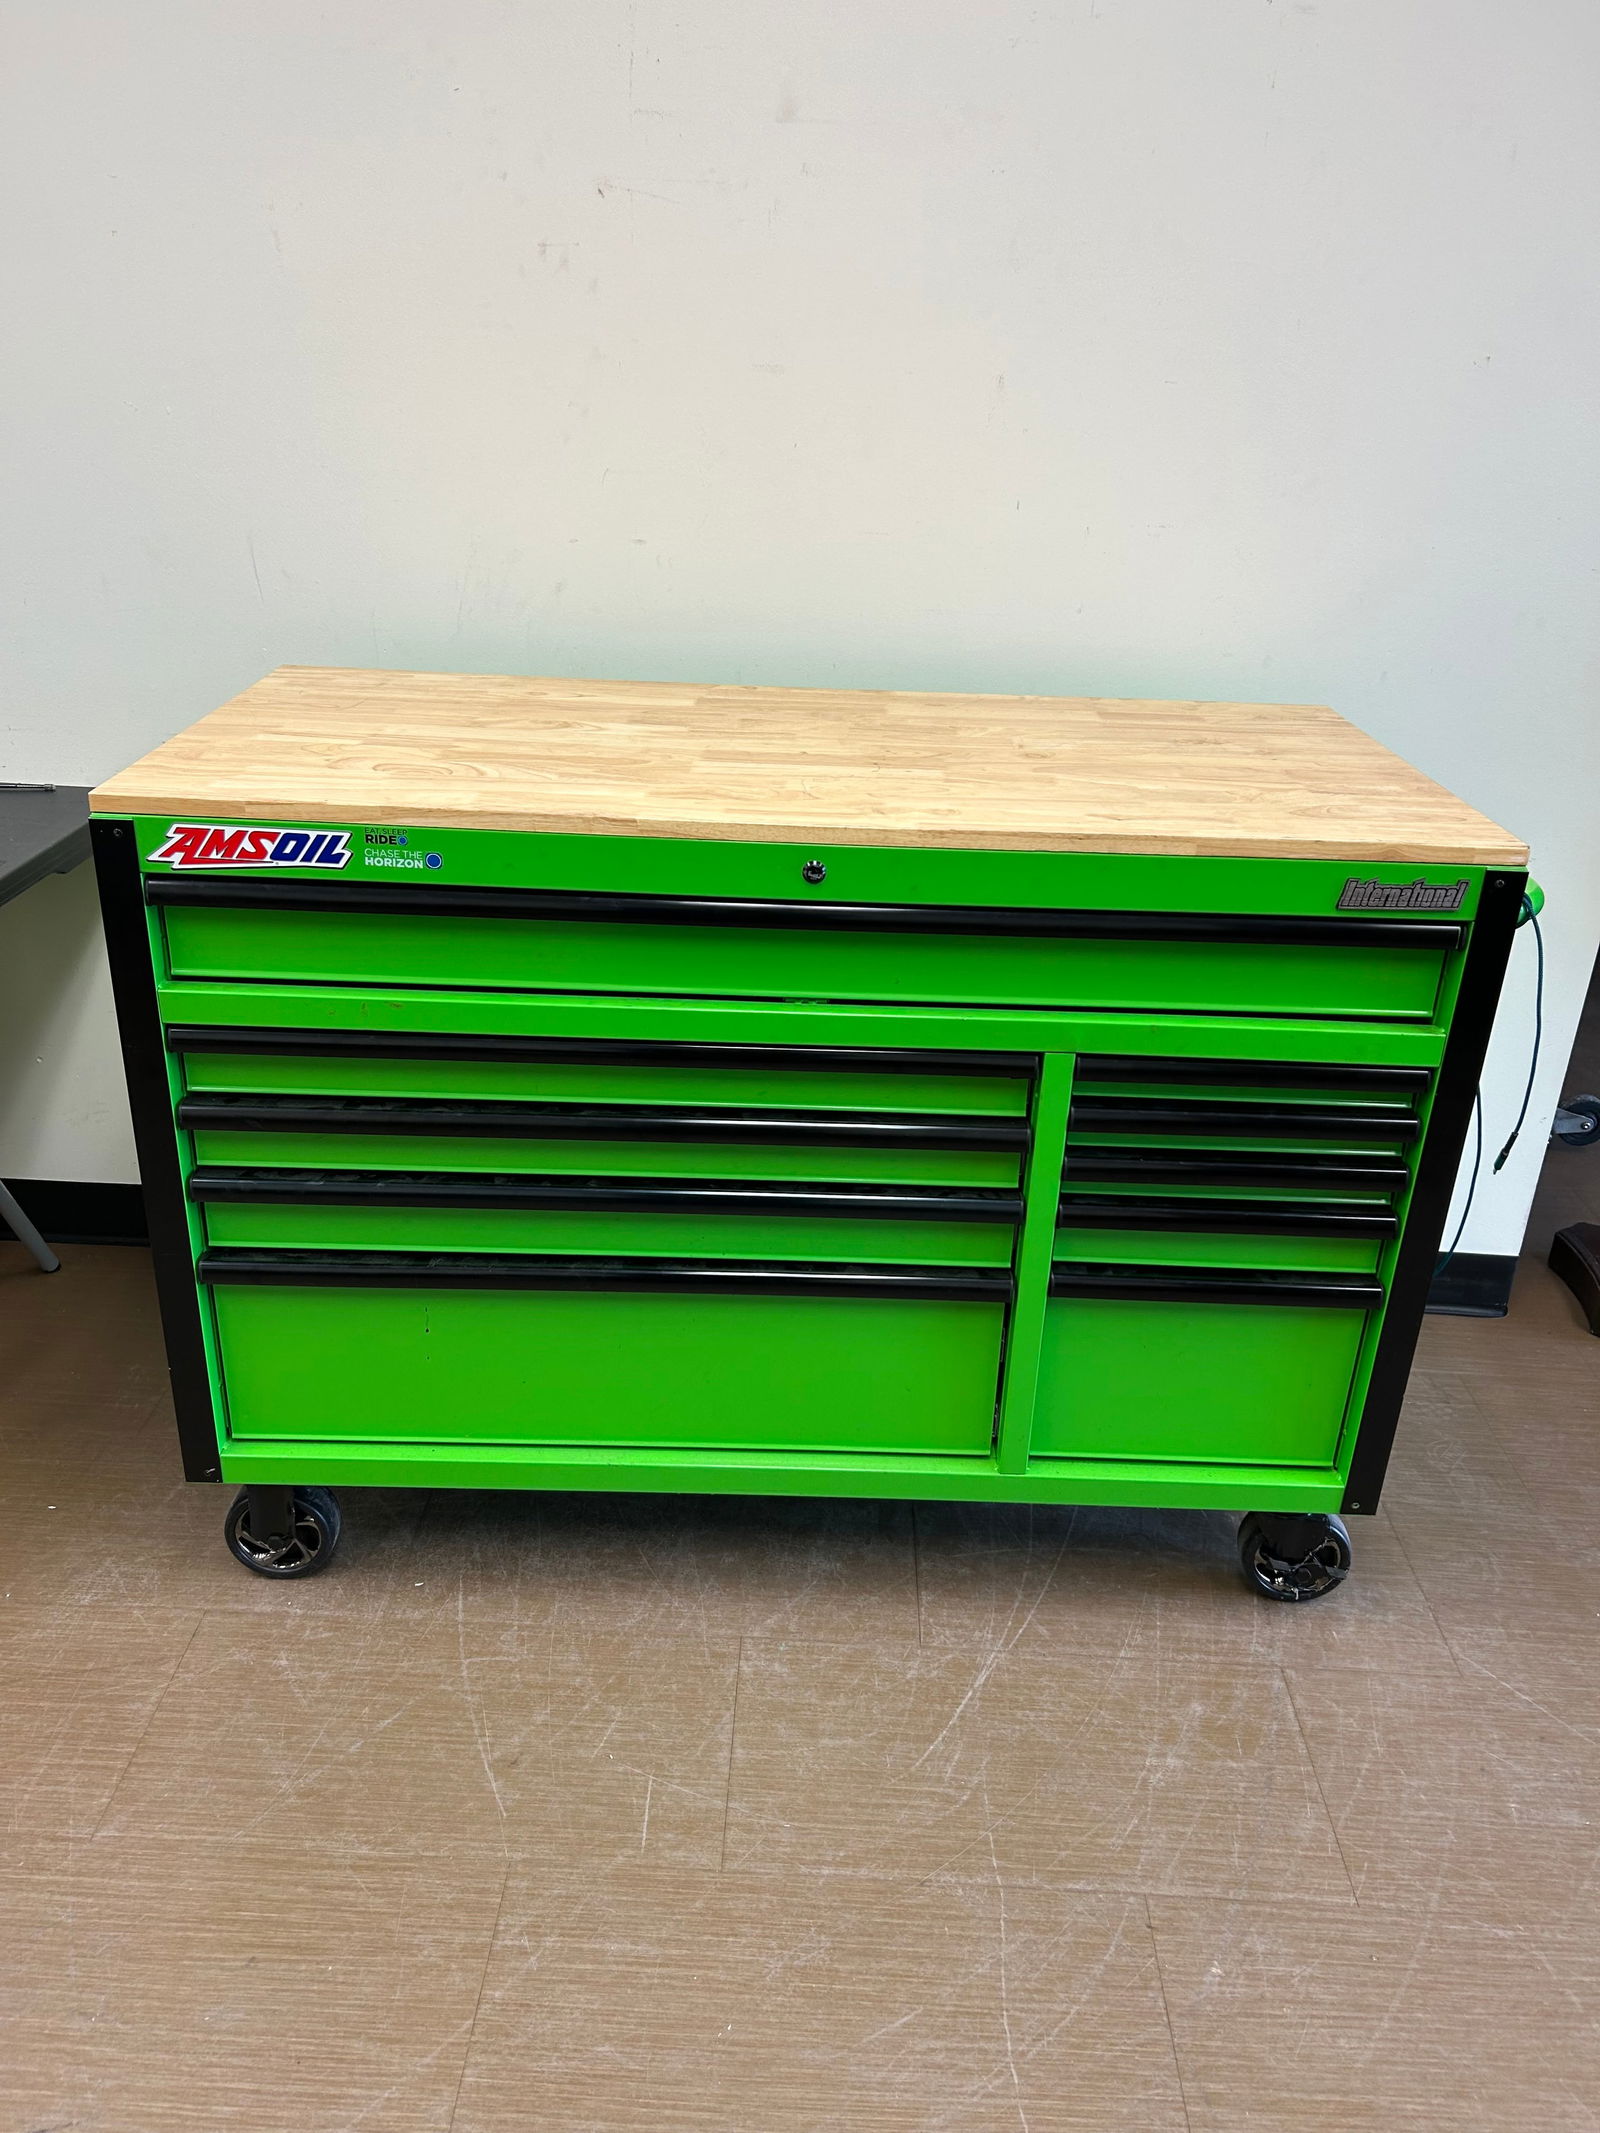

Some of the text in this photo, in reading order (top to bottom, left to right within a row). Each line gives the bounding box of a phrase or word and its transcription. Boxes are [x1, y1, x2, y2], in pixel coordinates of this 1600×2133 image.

[382, 828, 408, 836] SLEEP
[158, 825, 347, 866] AMSOIL
[365, 834, 397, 845] RIDE
[364, 848, 423, 860] CHASE THE
[364, 857, 424, 869] HORIZON
[1339, 878, 1469, 908] International
